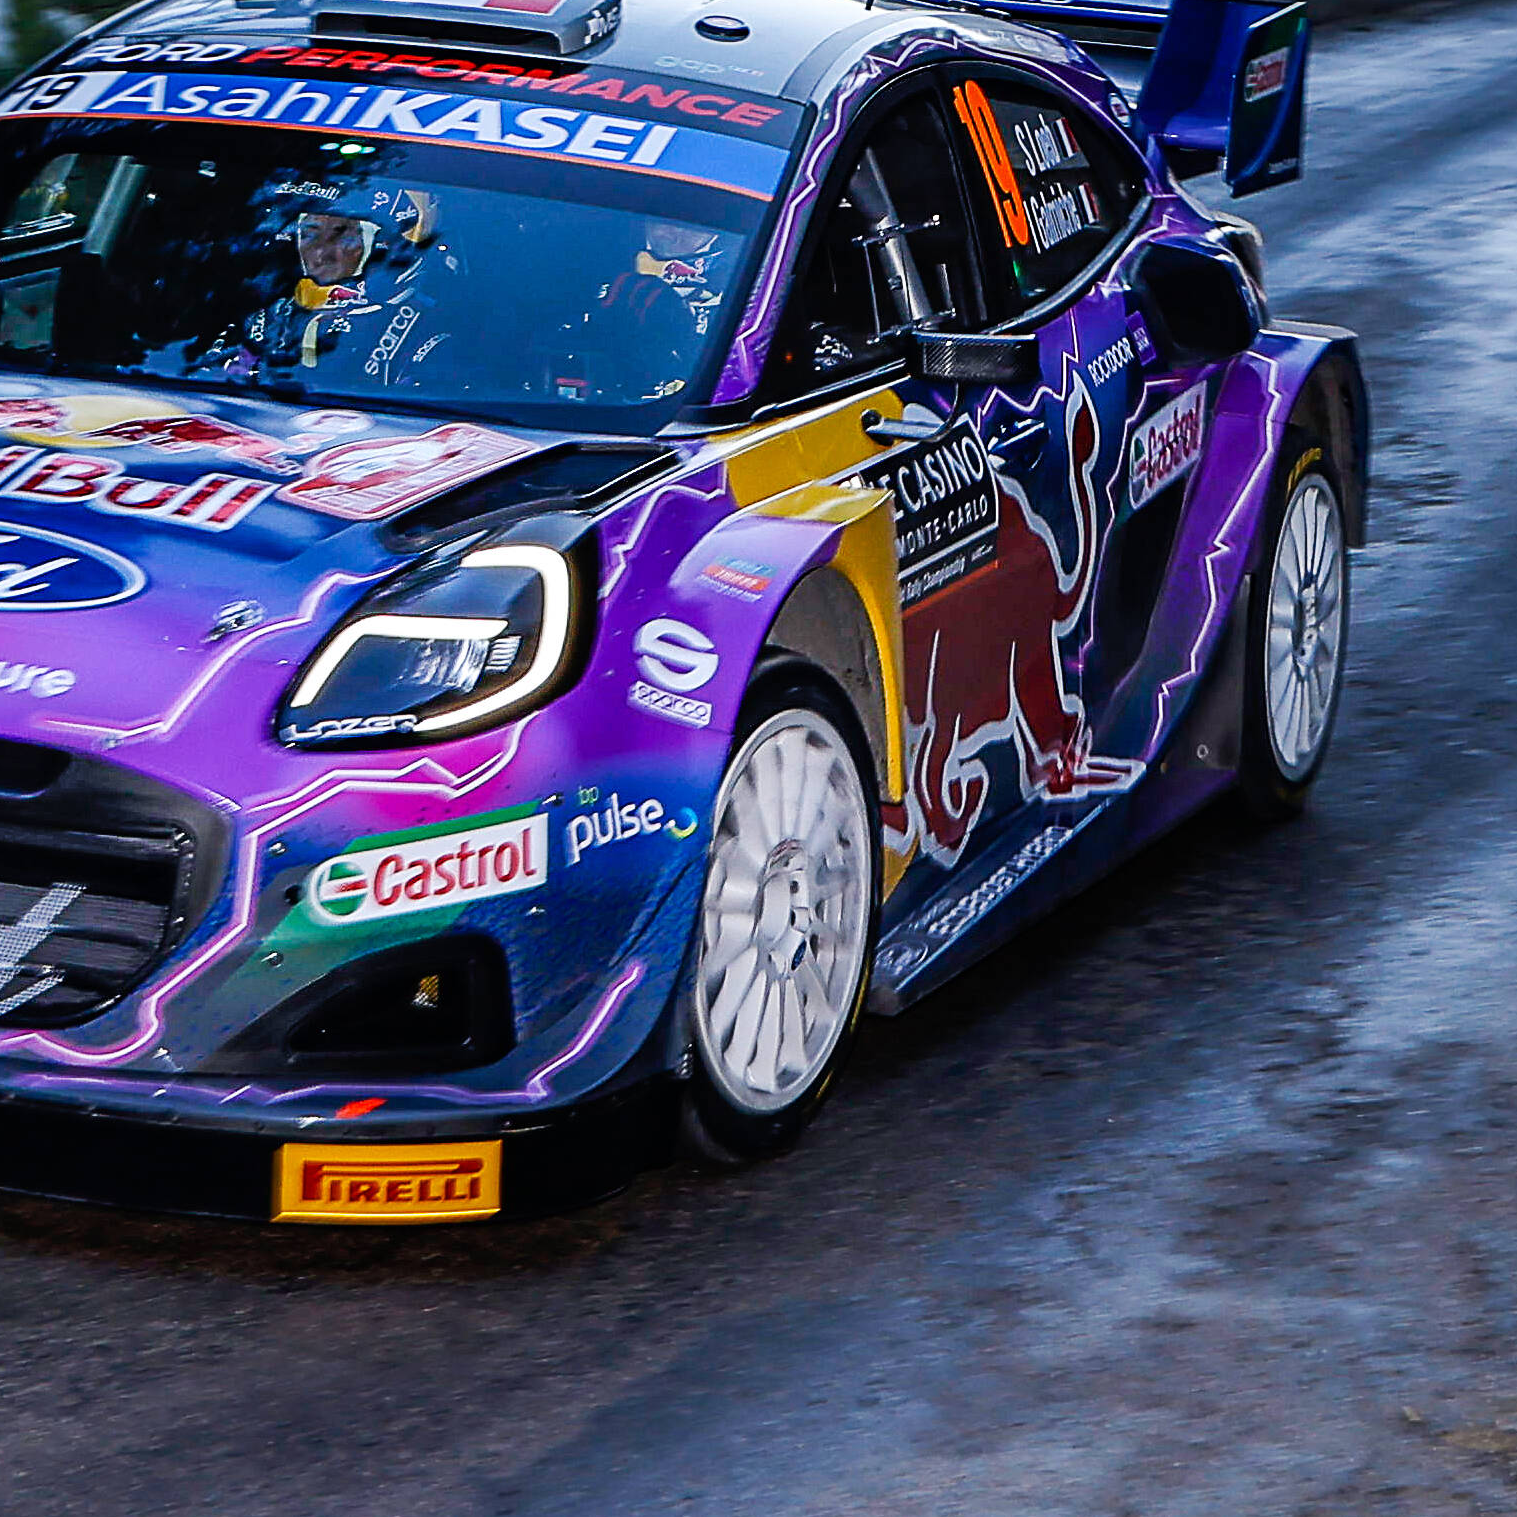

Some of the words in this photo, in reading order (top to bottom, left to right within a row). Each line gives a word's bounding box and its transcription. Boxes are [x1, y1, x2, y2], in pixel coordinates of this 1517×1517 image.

[3, 73, 82, 113] 19
[62, 42, 248, 66] FORD
[238, 46, 784, 128] PERFORMANCE
[952, 80, 1029, 249] 19
[1014, 124, 1037, 177] S
[364, 305, 415, 376] sparco
[897, 435, 985, 514] CASINO
[1145, 394, 1201, 489] Castrol
[568, 792, 665, 867] pulse
[579, 785, 600, 806] bp
[373, 827, 538, 907] Castrol
[301, 1157, 485, 1203] PIRELLI
